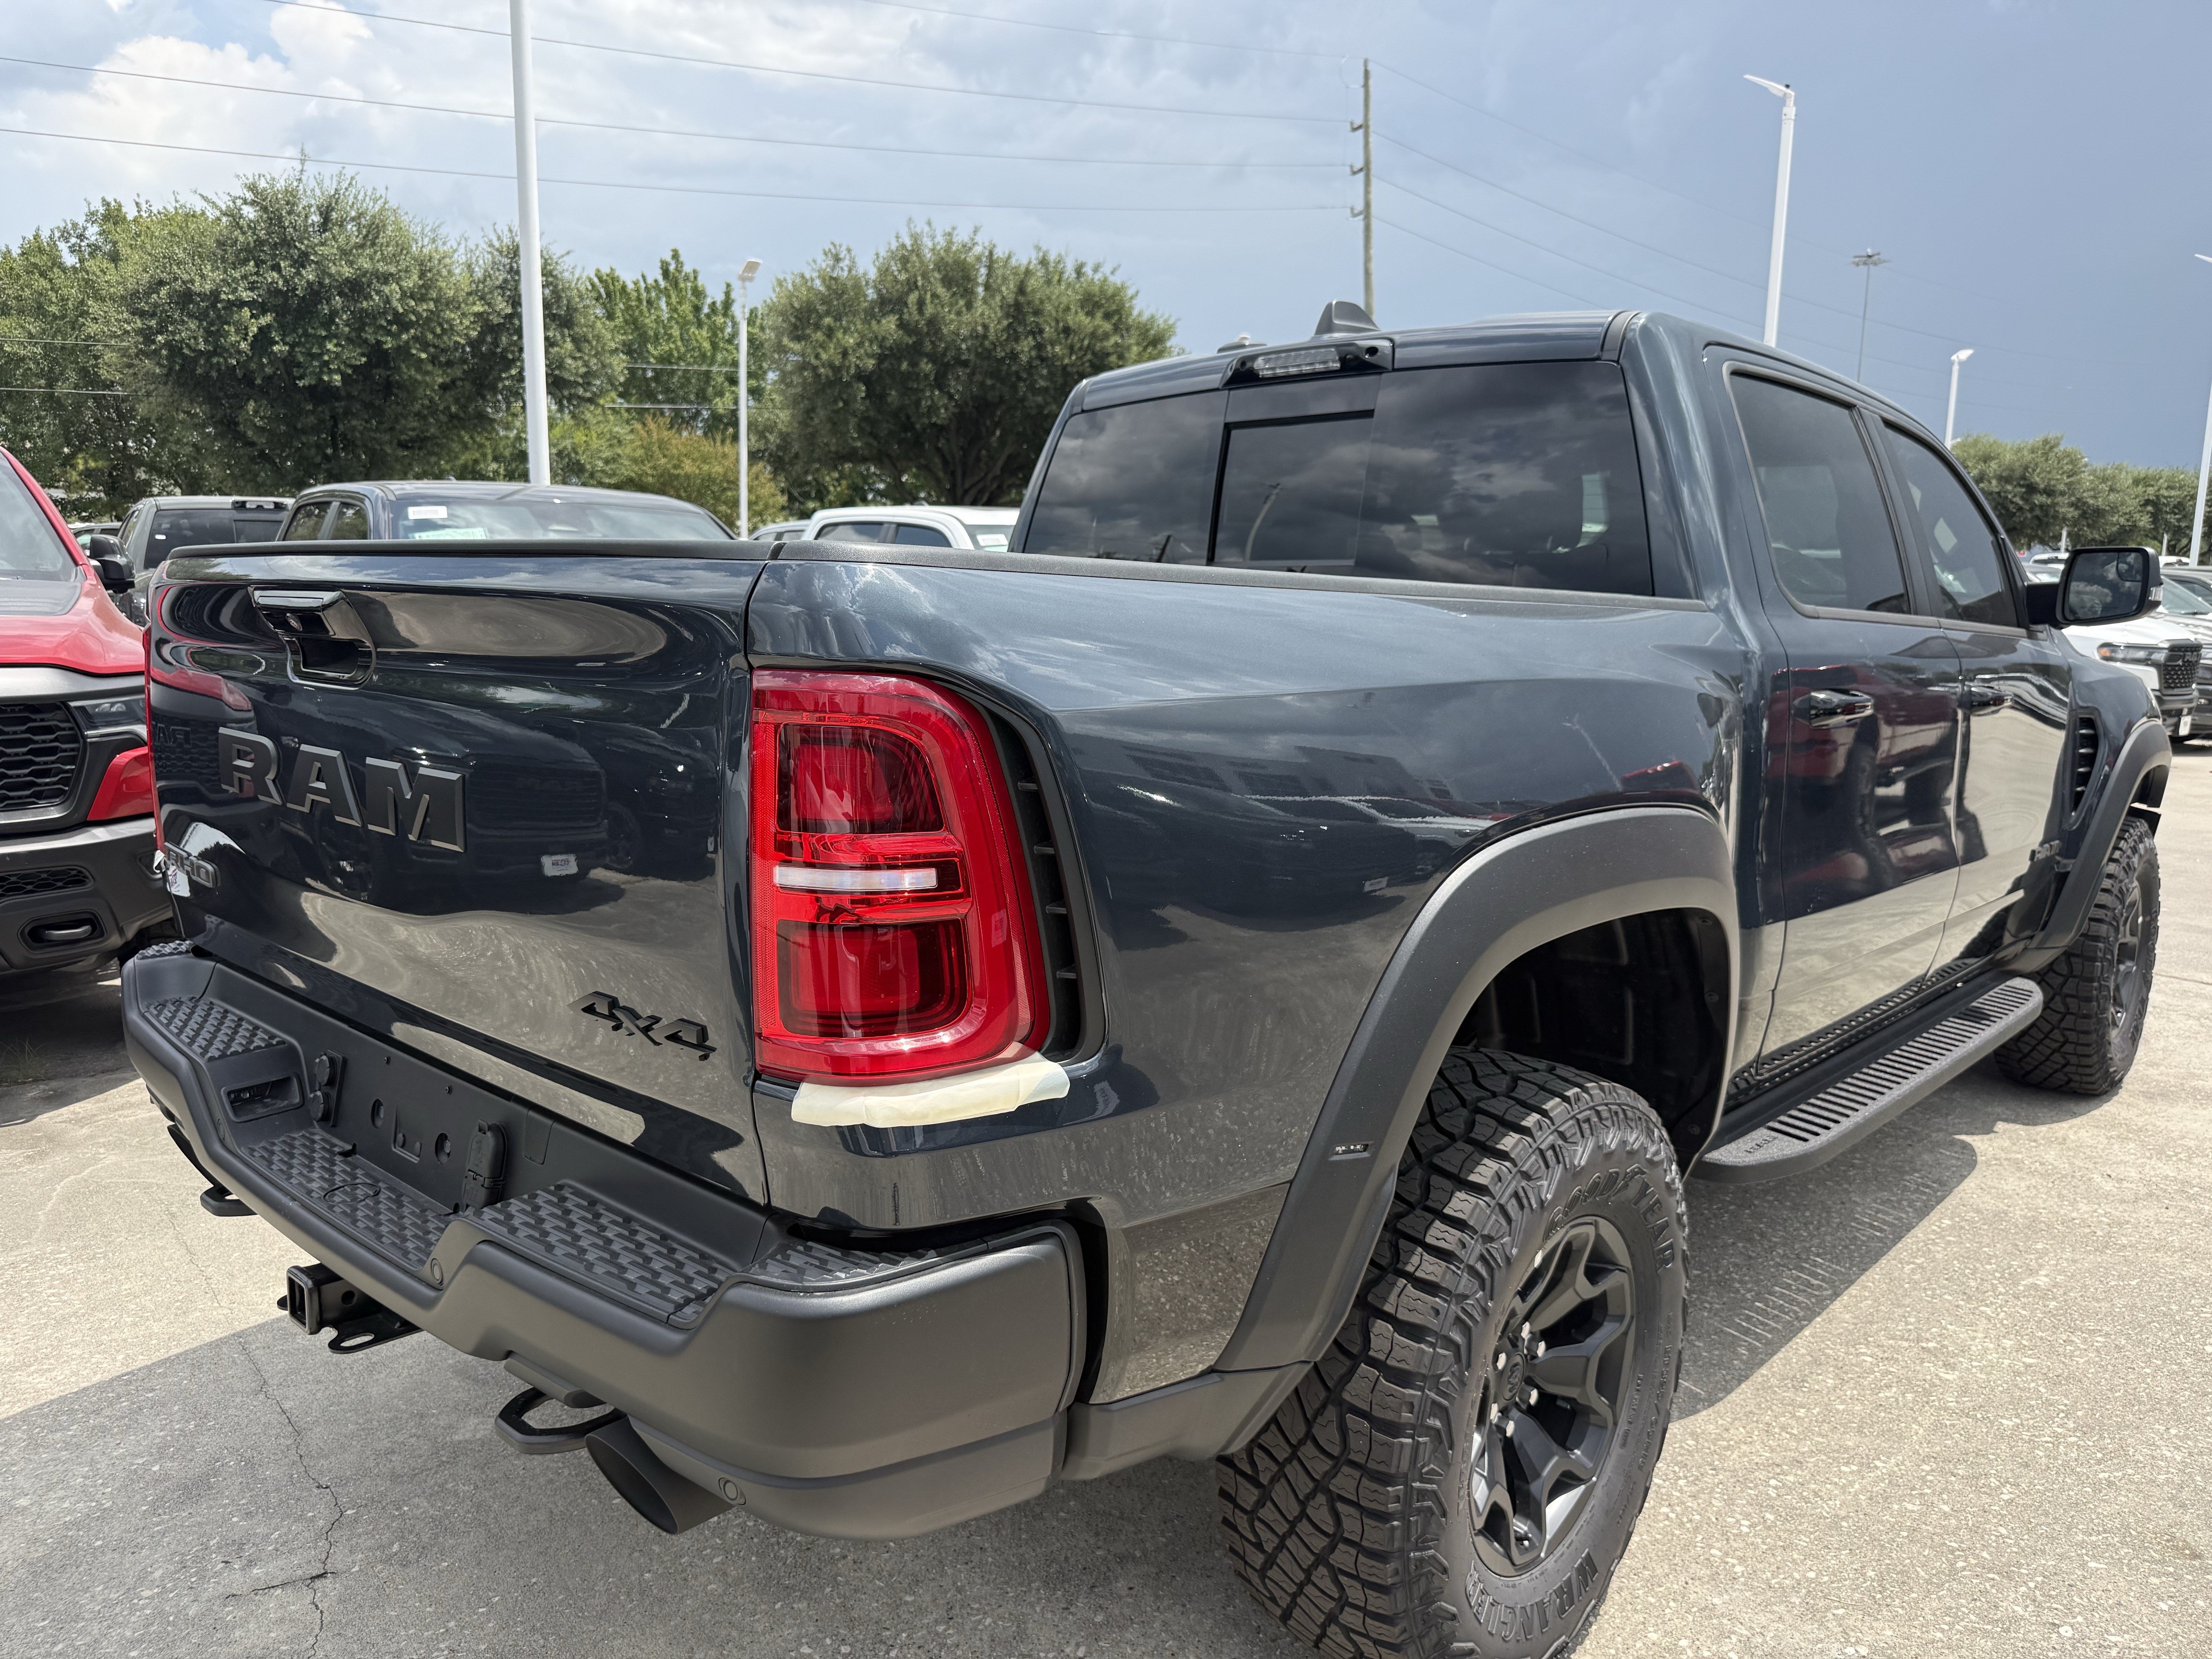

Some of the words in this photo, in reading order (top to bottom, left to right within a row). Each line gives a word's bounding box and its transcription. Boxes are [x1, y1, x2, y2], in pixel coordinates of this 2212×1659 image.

[218, 726, 466, 853] RAM
[165, 842, 220, 888] RHO
[1543, 1164, 1675, 1271] GOODYEAR
[1466, 1548, 1599, 1642] WRANGLER
